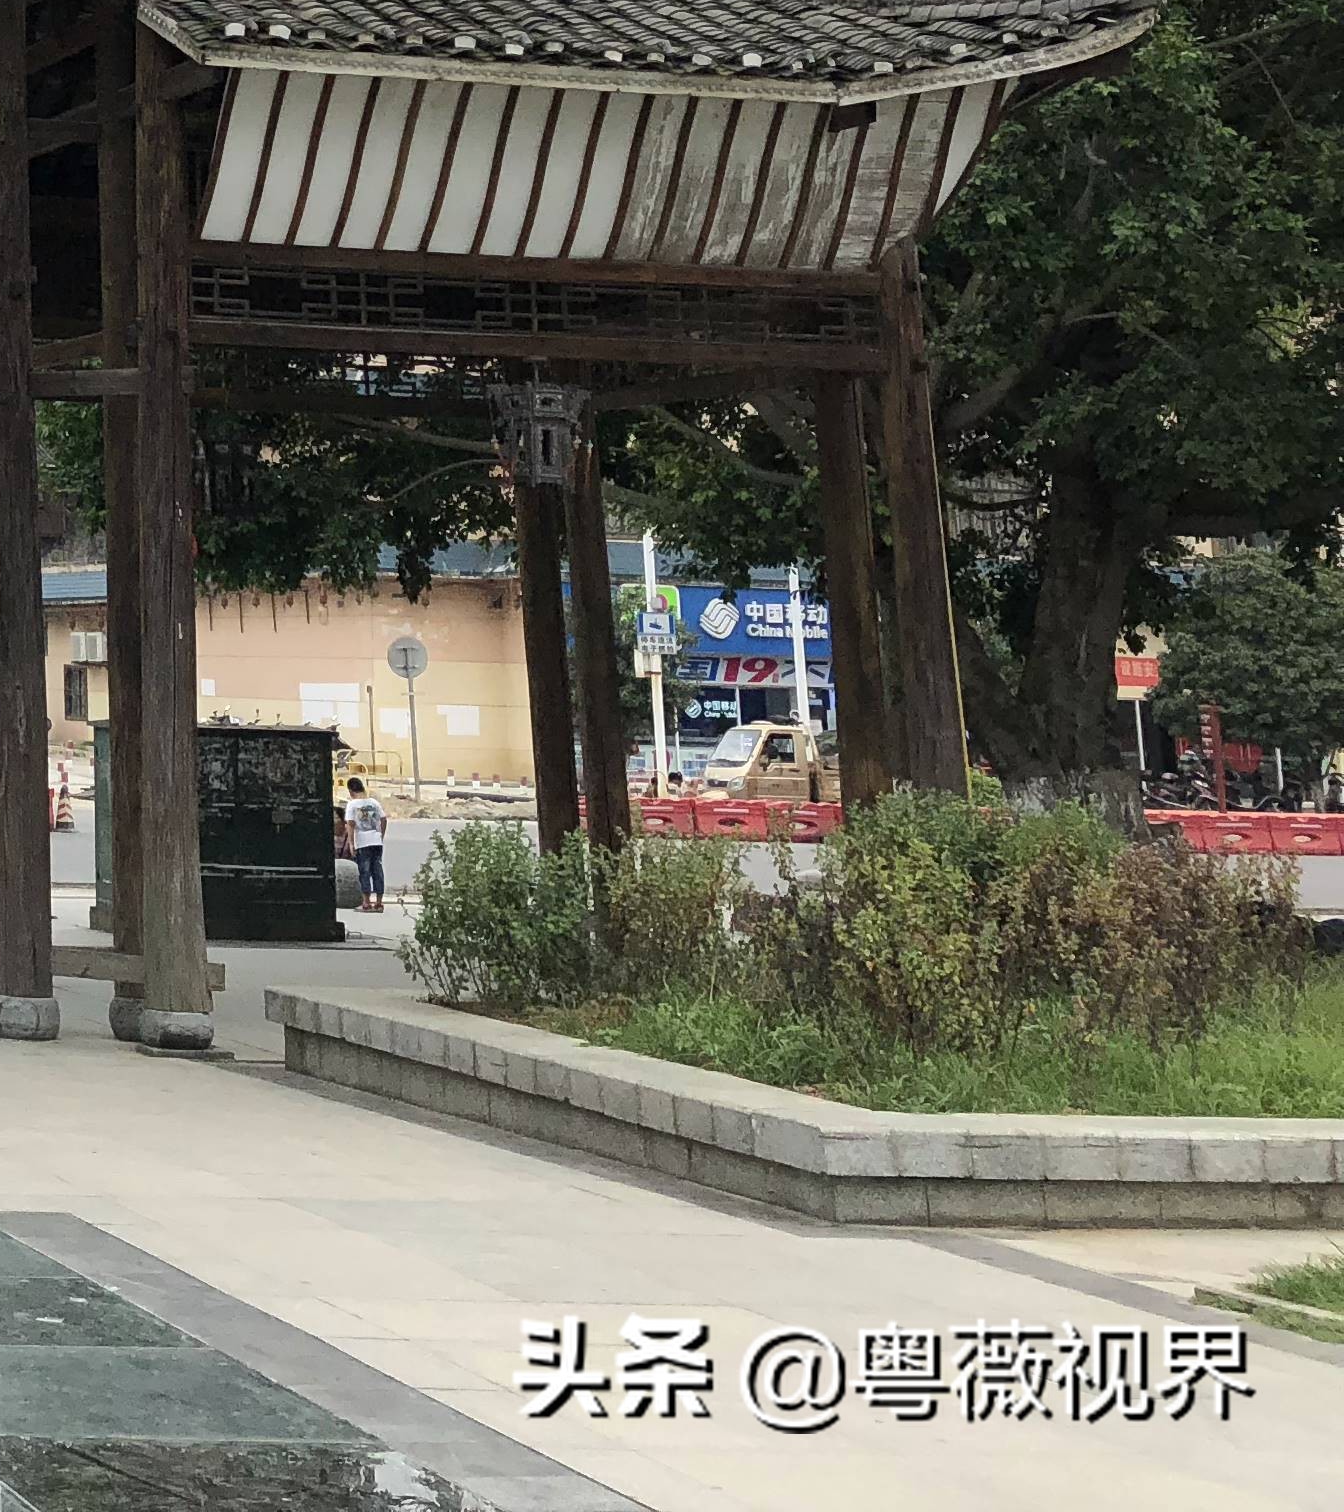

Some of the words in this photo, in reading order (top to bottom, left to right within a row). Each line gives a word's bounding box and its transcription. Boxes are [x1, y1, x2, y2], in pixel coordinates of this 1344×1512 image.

[744, 600, 829, 625] 中国移动
[746, 624, 784, 638] China
